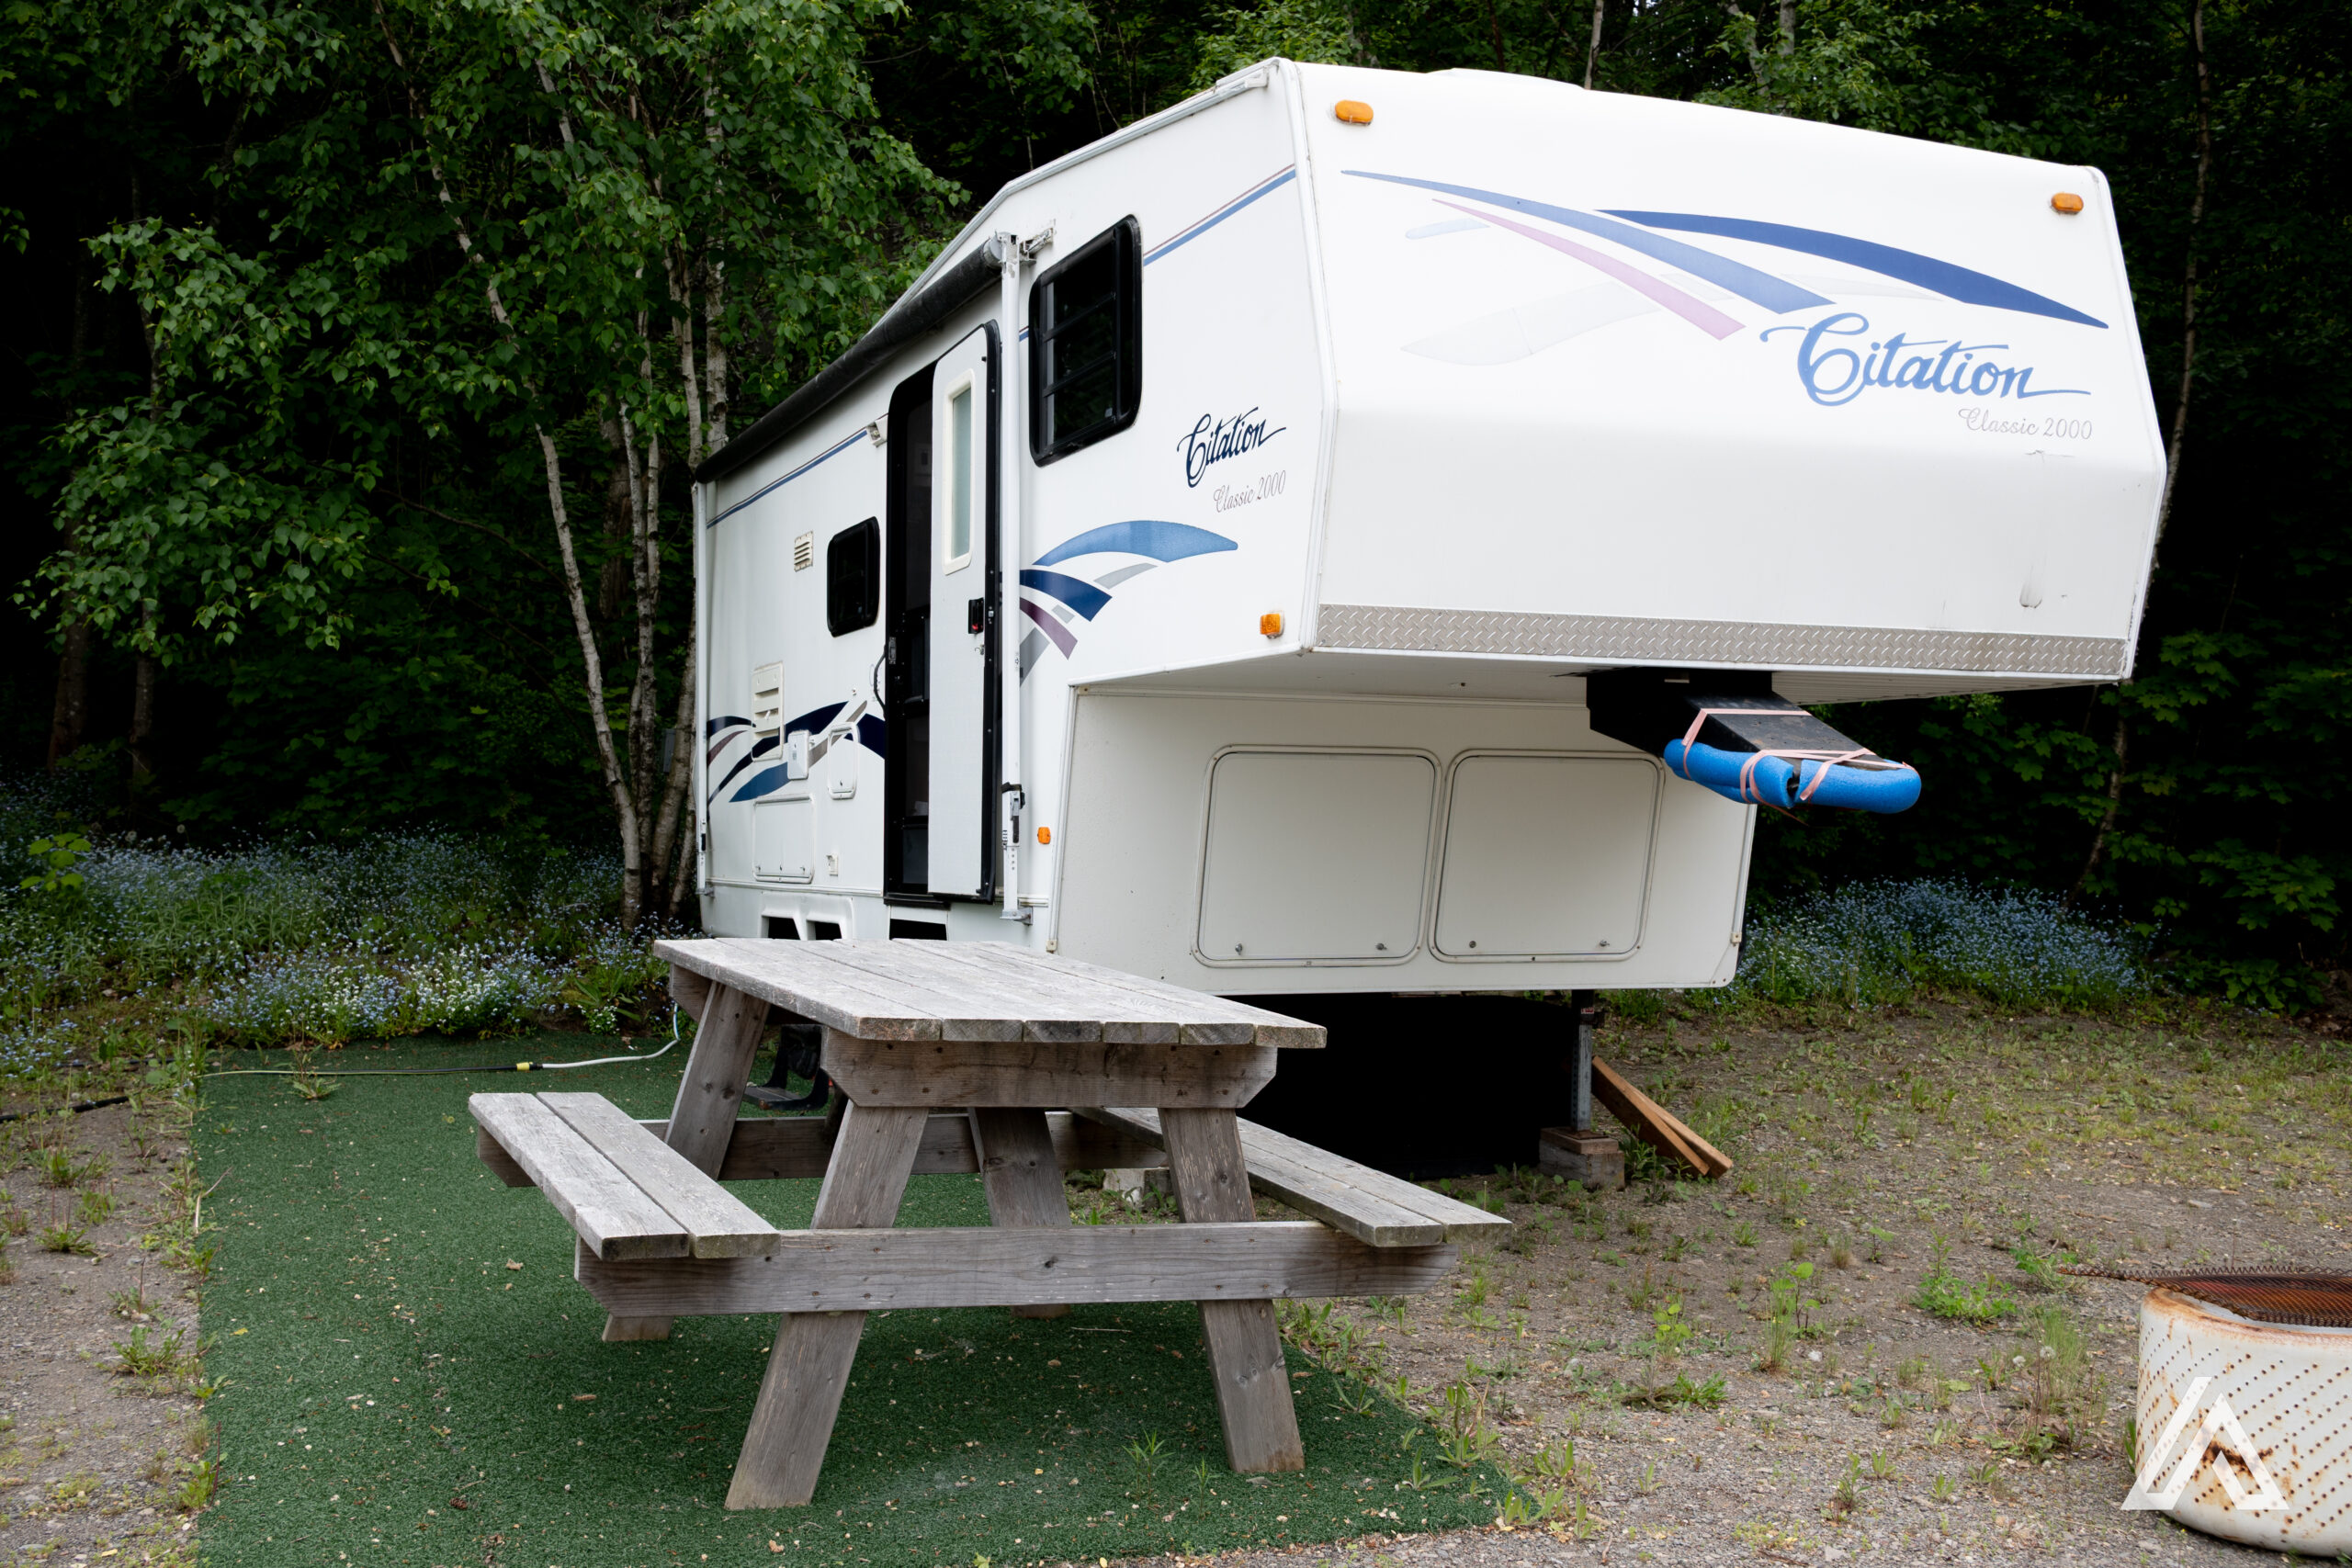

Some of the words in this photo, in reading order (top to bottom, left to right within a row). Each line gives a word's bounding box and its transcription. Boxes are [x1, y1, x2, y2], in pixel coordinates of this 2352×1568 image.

[1759, 312, 2091, 406] Citation
[1177, 406, 1286, 488] Citation
[1958, 408, 2040, 436] Classic
[2042, 416, 2093, 440] 2000
[1213, 484, 1255, 513] Classic
[1256, 469, 1286, 501] 2000
